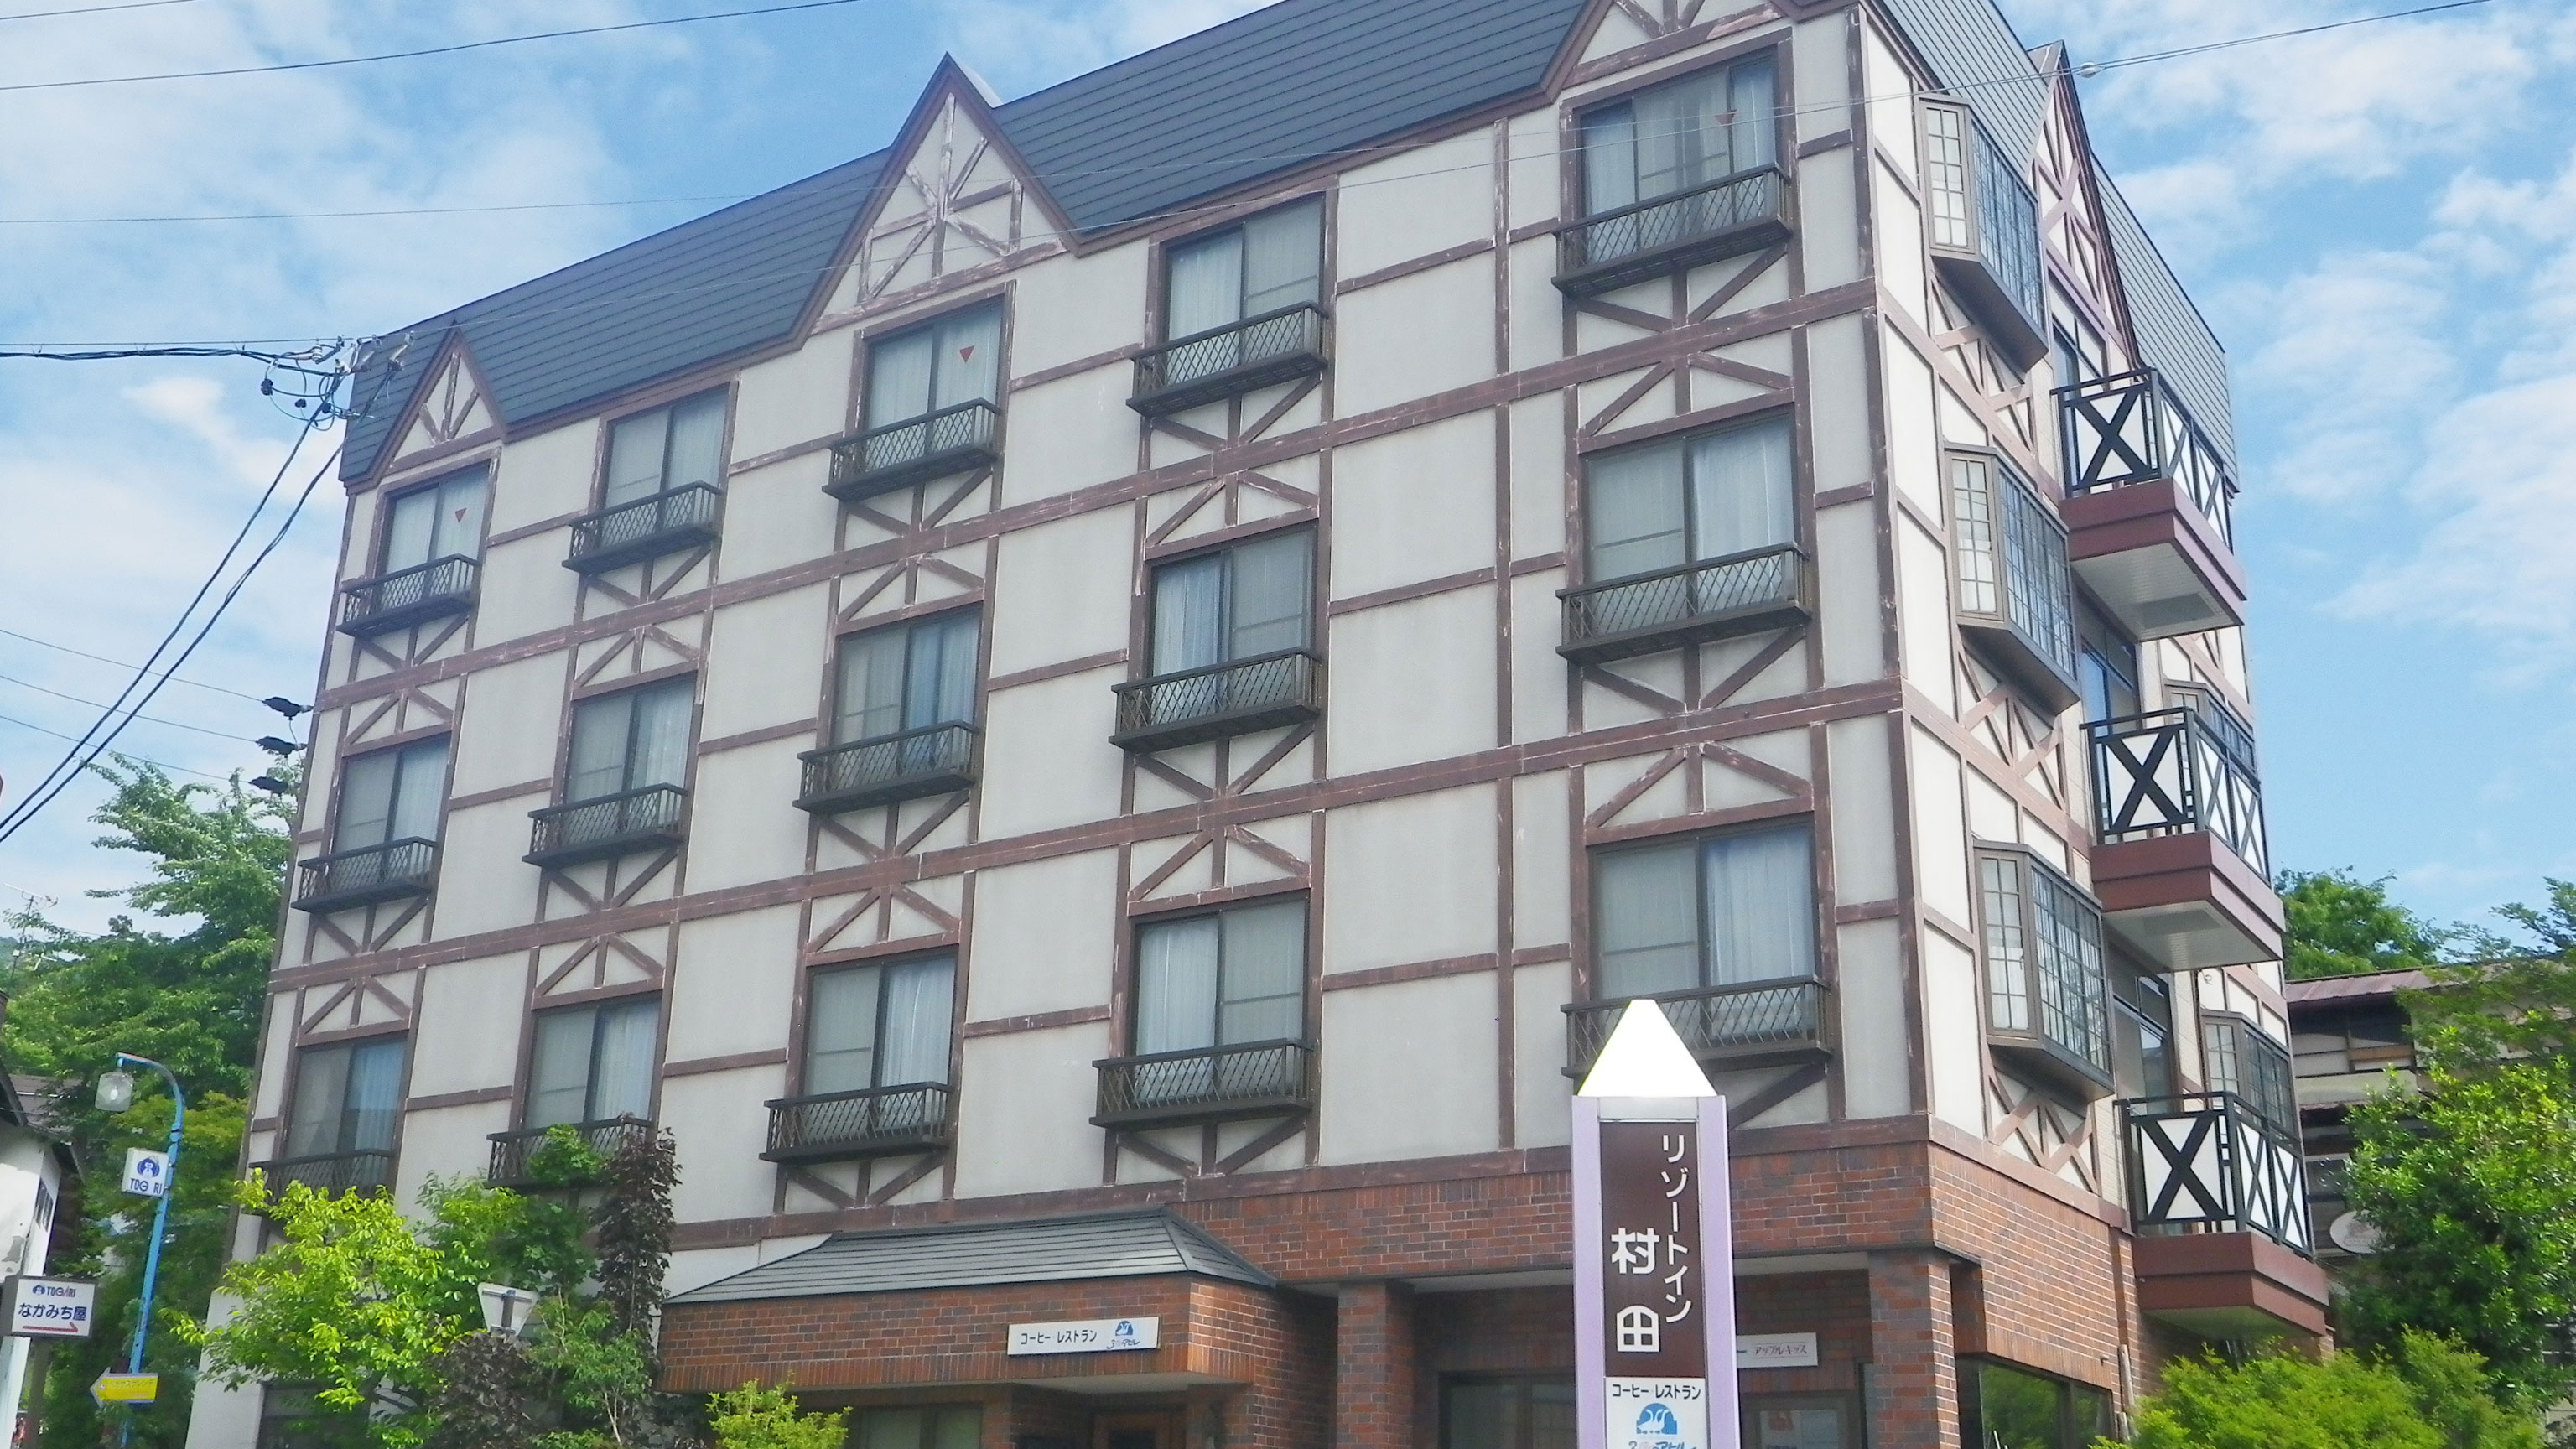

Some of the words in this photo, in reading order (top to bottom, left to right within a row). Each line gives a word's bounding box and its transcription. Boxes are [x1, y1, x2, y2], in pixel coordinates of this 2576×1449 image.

[1660, 1135, 1692, 1323] リゾートイン
[1611, 1227, 1660, 1353] 村田
[18, 1303, 87, 1322] なかみち屋
[1021, 1332, 1051, 1345] コーヒー
[1057, 1329, 1098, 1343] レストラン
[1612, 1384, 1649, 1399] コーヒー
[1655, 1384, 1701, 1400] レストラン
